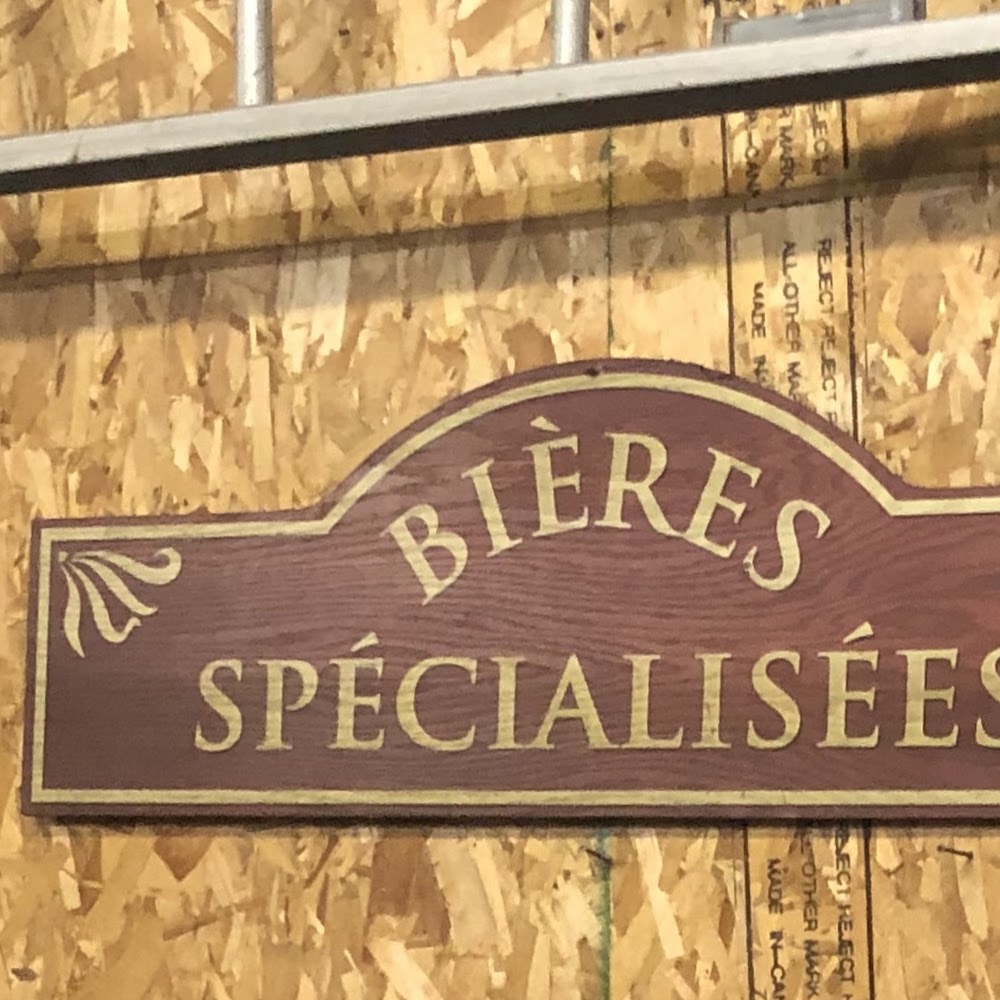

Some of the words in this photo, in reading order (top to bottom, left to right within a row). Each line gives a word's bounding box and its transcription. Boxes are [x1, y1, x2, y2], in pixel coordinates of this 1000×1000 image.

[751, 281, 766, 339] MADE
[818, 238, 834, 315] REJECT
[383, 416, 831, 605] BIÈRES
[768, 858, 783, 915] MADE
[801, 861, 818, 932] OTHER
